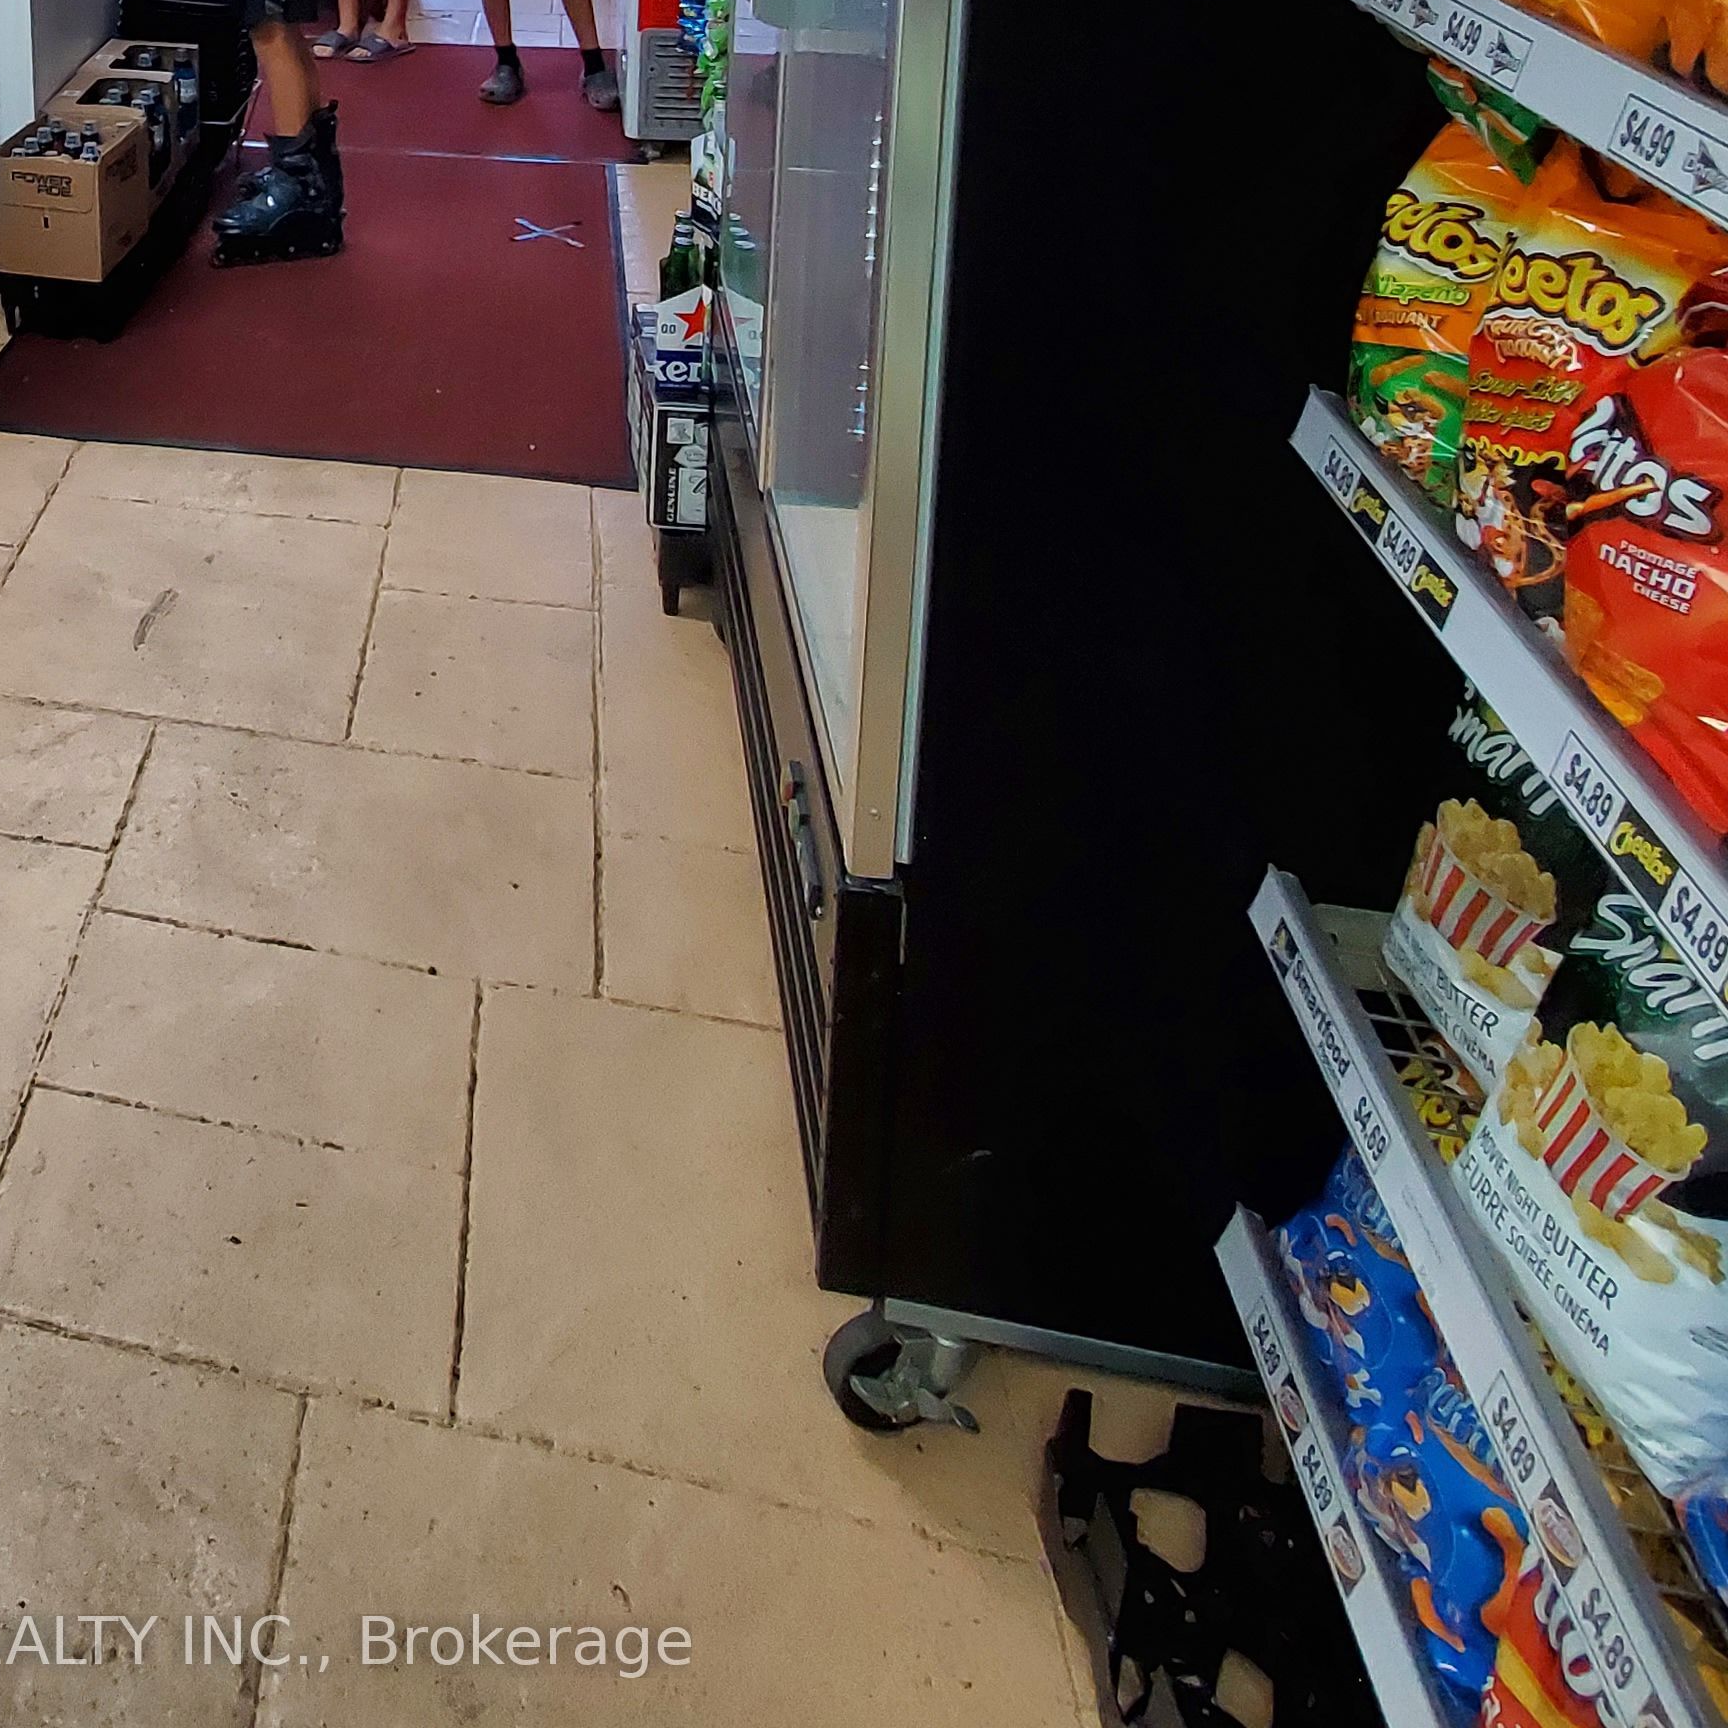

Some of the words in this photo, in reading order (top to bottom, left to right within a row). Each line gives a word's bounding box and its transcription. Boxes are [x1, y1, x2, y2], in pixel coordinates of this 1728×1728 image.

[11, 171, 73, 185] POWER
[1598, 542, 1697, 601] NACHO
[1619, 539, 1698, 579] FROMAGE
[1632, 581, 1691, 615] CHEESE
[1609, 820, 1673, 886] Cheetos
[1292, 959, 1351, 1079] Smartfood
[1435, 968, 1500, 1039] BUTTER
[1476, 1124, 1509, 1174] MOVIE
[1503, 1168, 1542, 1223] NIGHT
[1541, 1213, 1619, 1311] BUTTER
[1505, 1225, 1555, 1291] SOIRÉE
[1553, 1282, 1610, 1358] CINÉMA
[1581, 1586, 1636, 1691] $4.89
